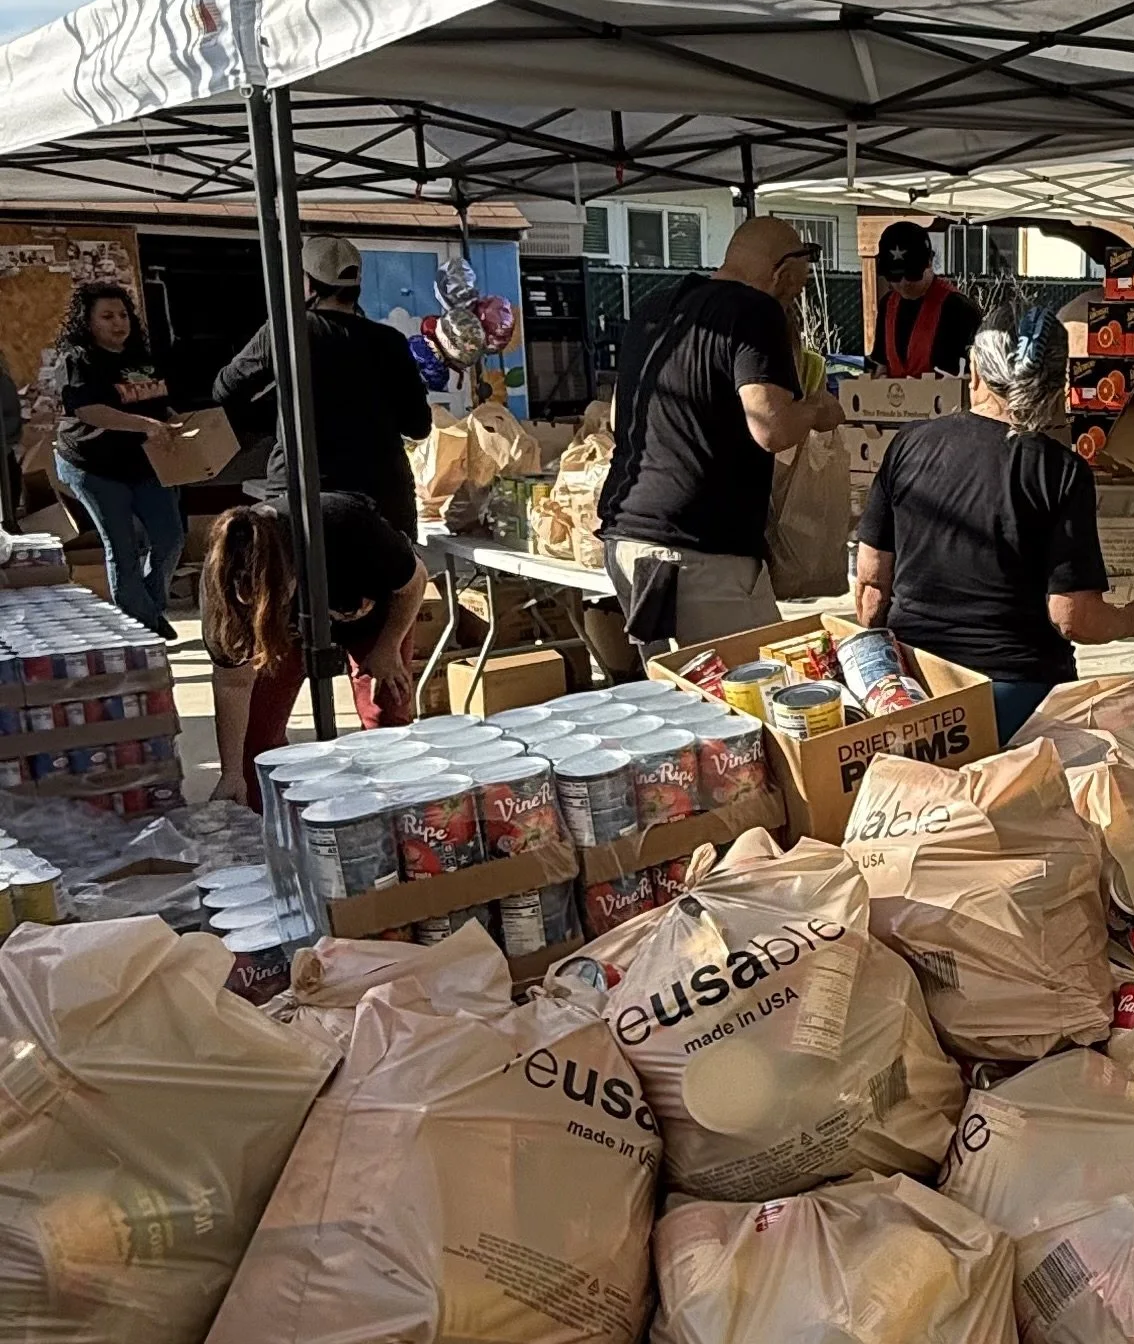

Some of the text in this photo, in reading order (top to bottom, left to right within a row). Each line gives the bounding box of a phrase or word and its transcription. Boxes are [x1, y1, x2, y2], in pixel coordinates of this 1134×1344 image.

[838, 706, 966, 763] DRIED PITTED
[402, 813, 449, 842] Ripe
[862, 853, 886, 869] USA
[603, 918, 846, 1046] eusable
[683, 986, 799, 1054] made in USA
[566, 1120, 616, 1149] made
[618, 1137, 635, 1158] in
